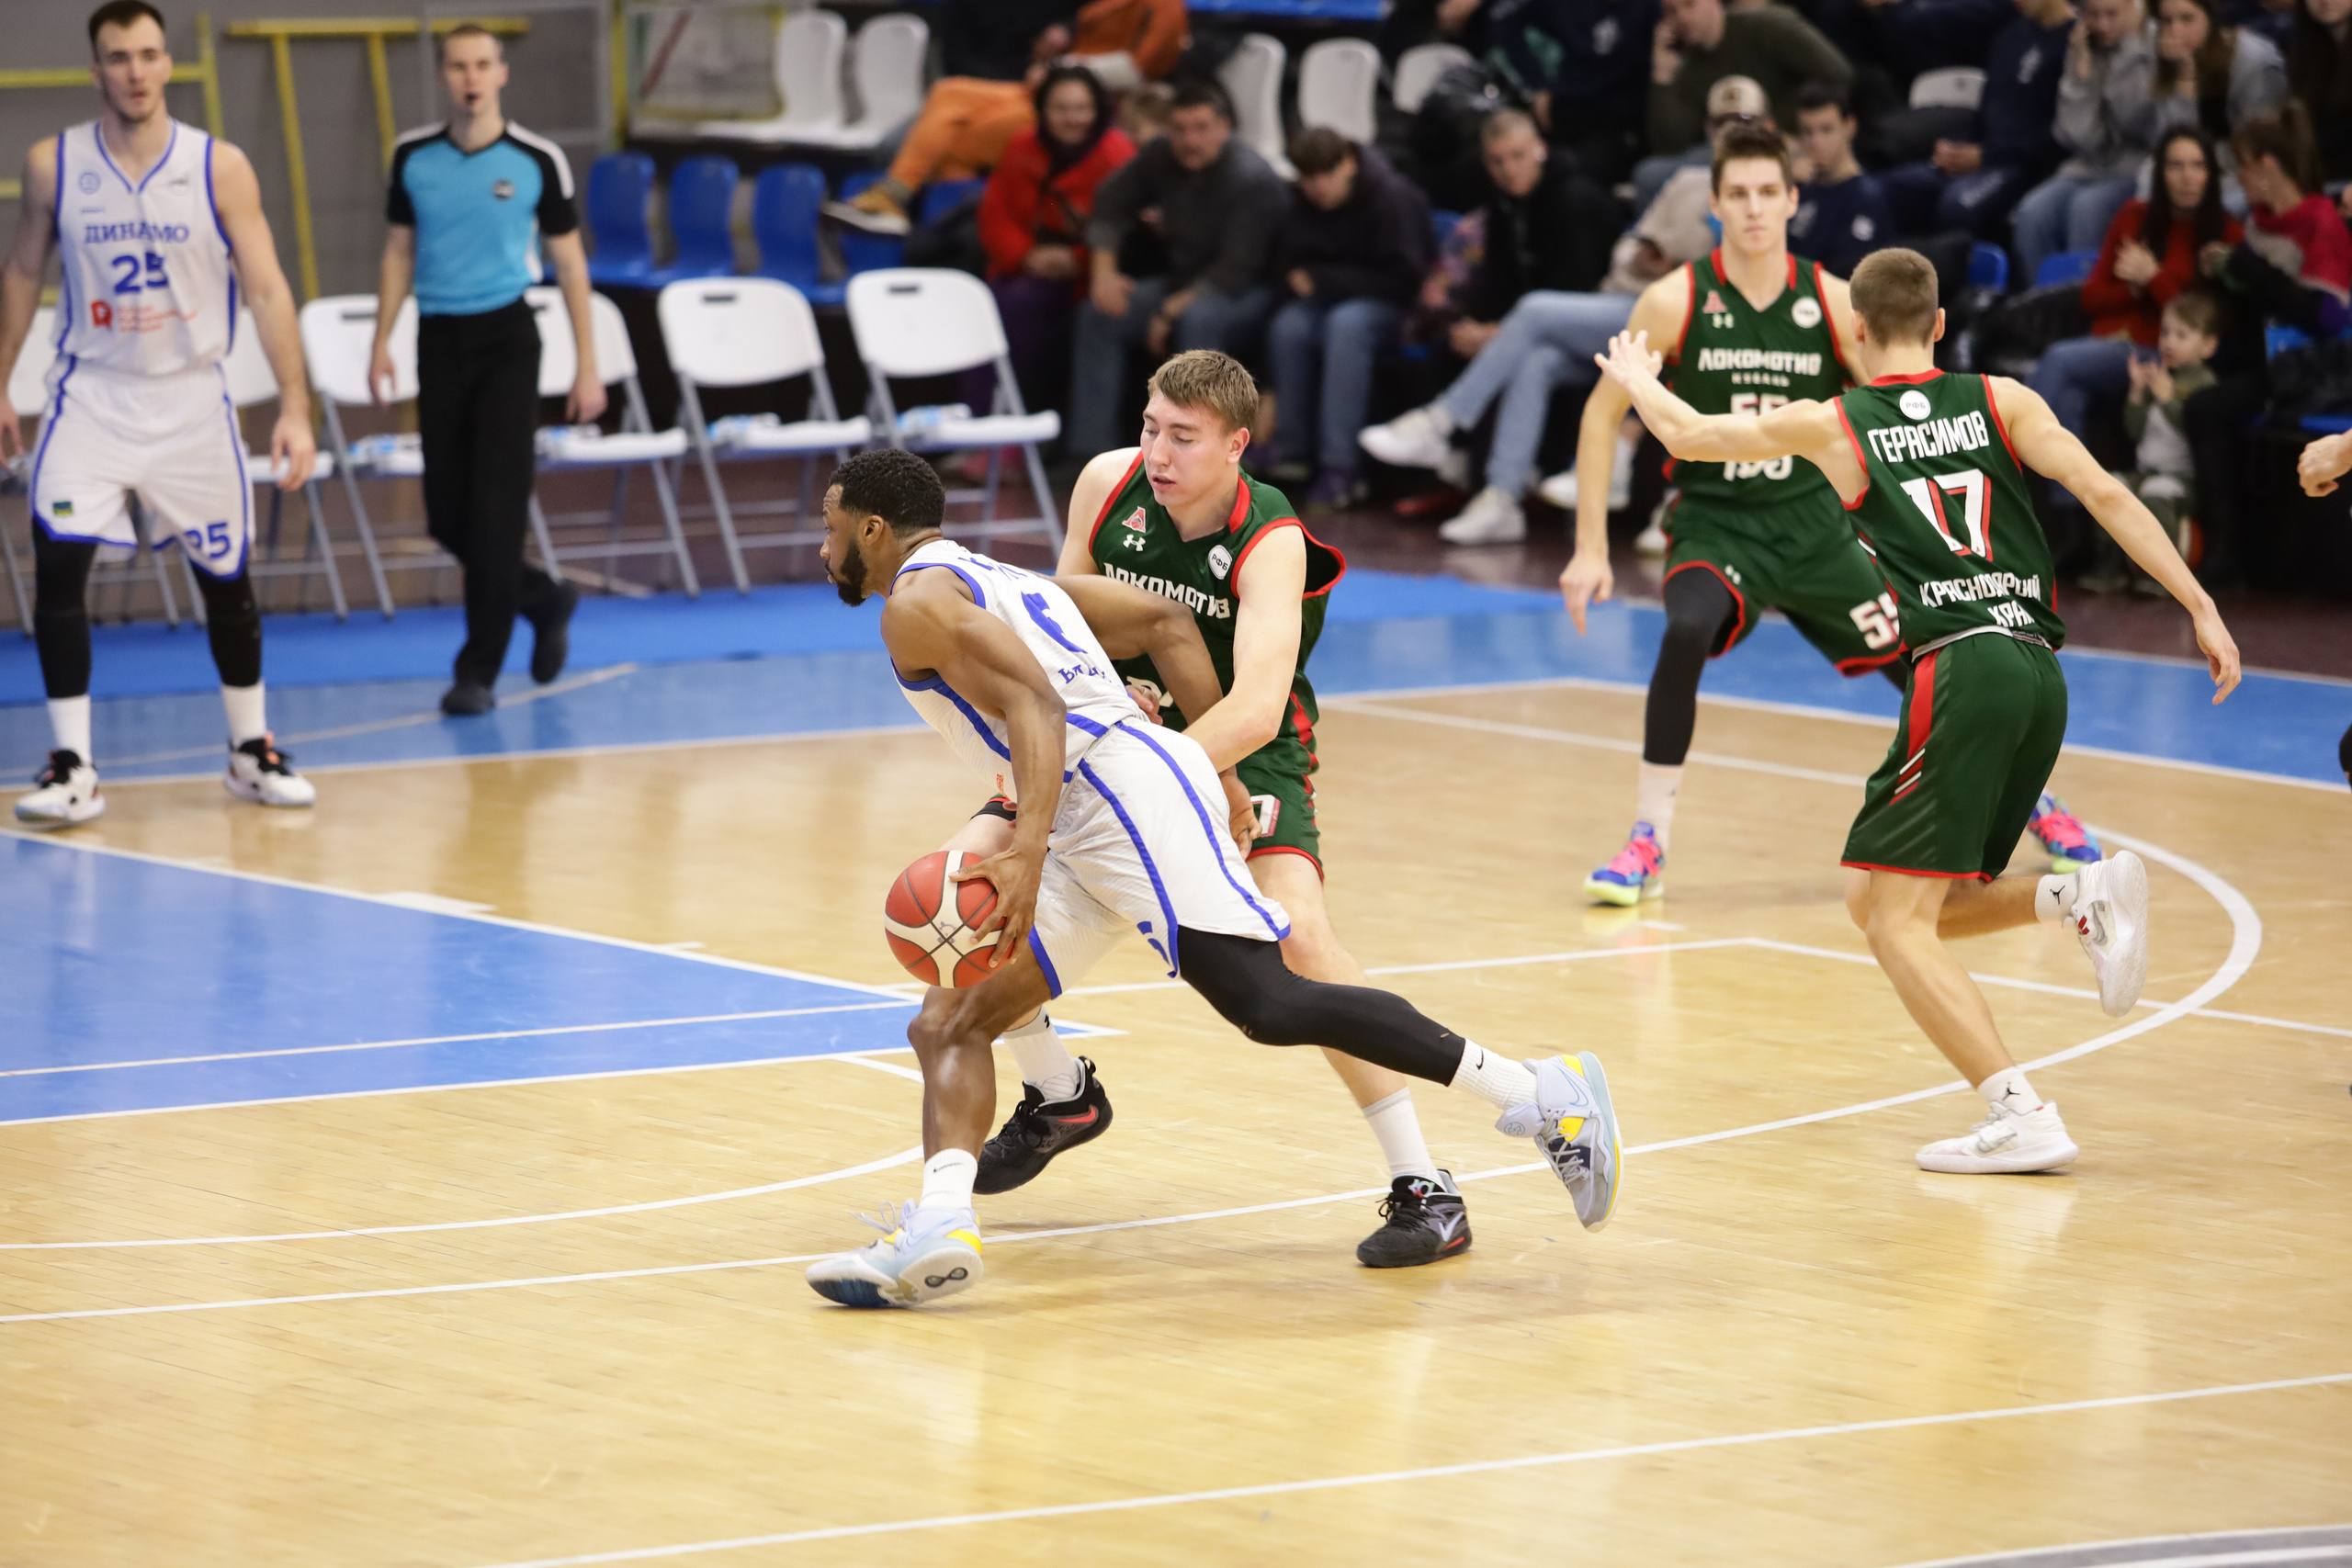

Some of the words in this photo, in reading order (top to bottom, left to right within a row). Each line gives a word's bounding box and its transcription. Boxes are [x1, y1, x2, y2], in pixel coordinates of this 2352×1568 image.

[85, 220, 190, 243] ДИНАМО
[111, 252, 169, 294] 25
[1905, 401, 1927, 410] РФБ
[1867, 410, 1990, 463] ГЕРАСИМОВ
[1899, 468, 1994, 562] 17
[1211, 553, 1228, 570] РФБ
